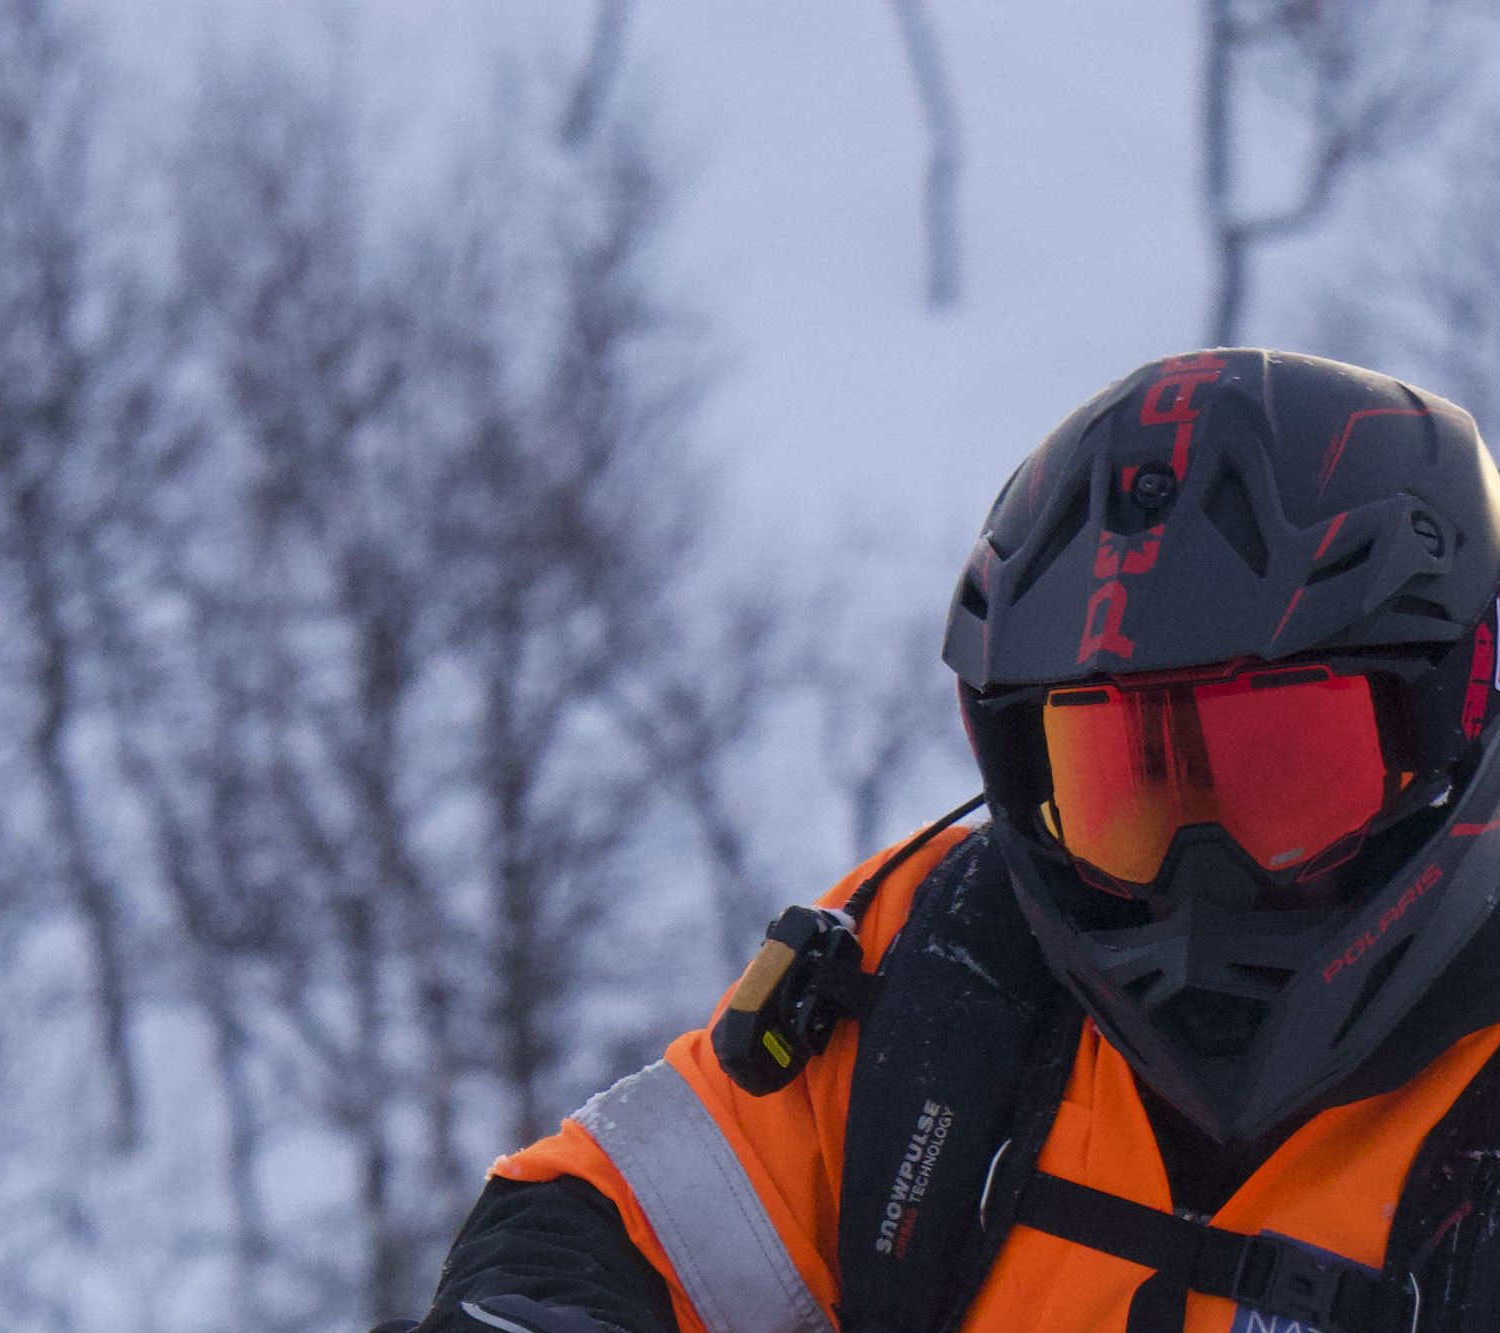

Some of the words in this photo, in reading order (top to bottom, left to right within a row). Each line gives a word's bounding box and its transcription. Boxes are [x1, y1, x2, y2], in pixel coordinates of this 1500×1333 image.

[1322, 863, 1443, 984] POLARIS
[875, 1099, 941, 1255] SNOWPULSE
[909, 1106, 954, 1202] TECHNOLOGY
